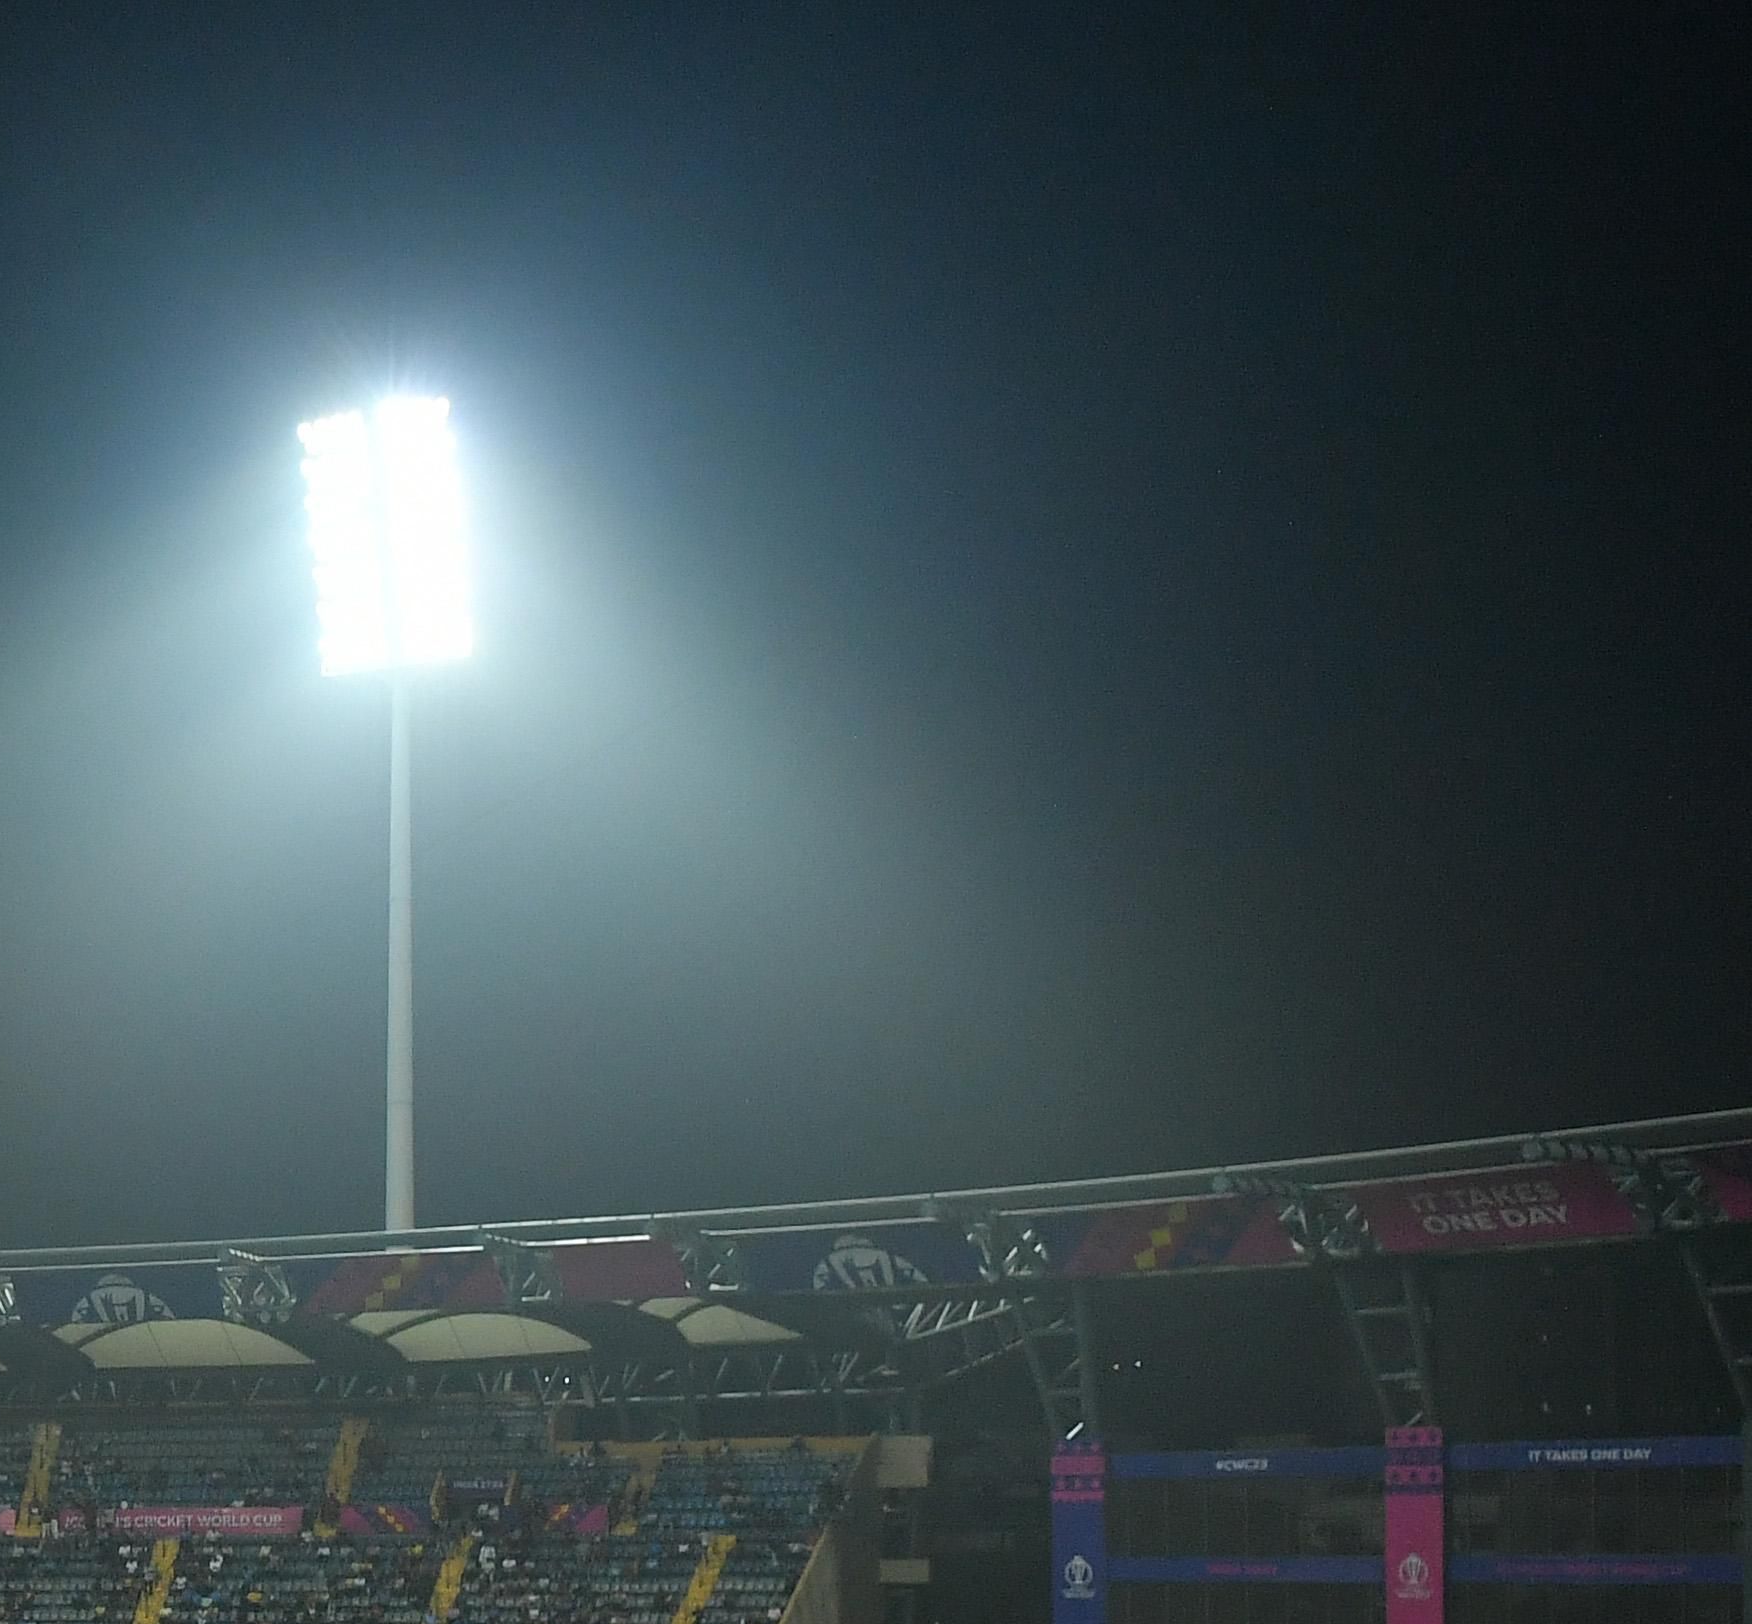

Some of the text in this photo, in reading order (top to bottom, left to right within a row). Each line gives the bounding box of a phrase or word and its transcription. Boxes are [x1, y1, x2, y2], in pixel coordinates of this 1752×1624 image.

[1423, 1203, 1568, 1234] ONE DAY
[1528, 1447, 1653, 1462] IT TAKES ONE DAY
[135, 1515, 193, 1528] CRICKET
[196, 1514, 251, 1528] WORLD
[252, 1514, 283, 1527] CUP
